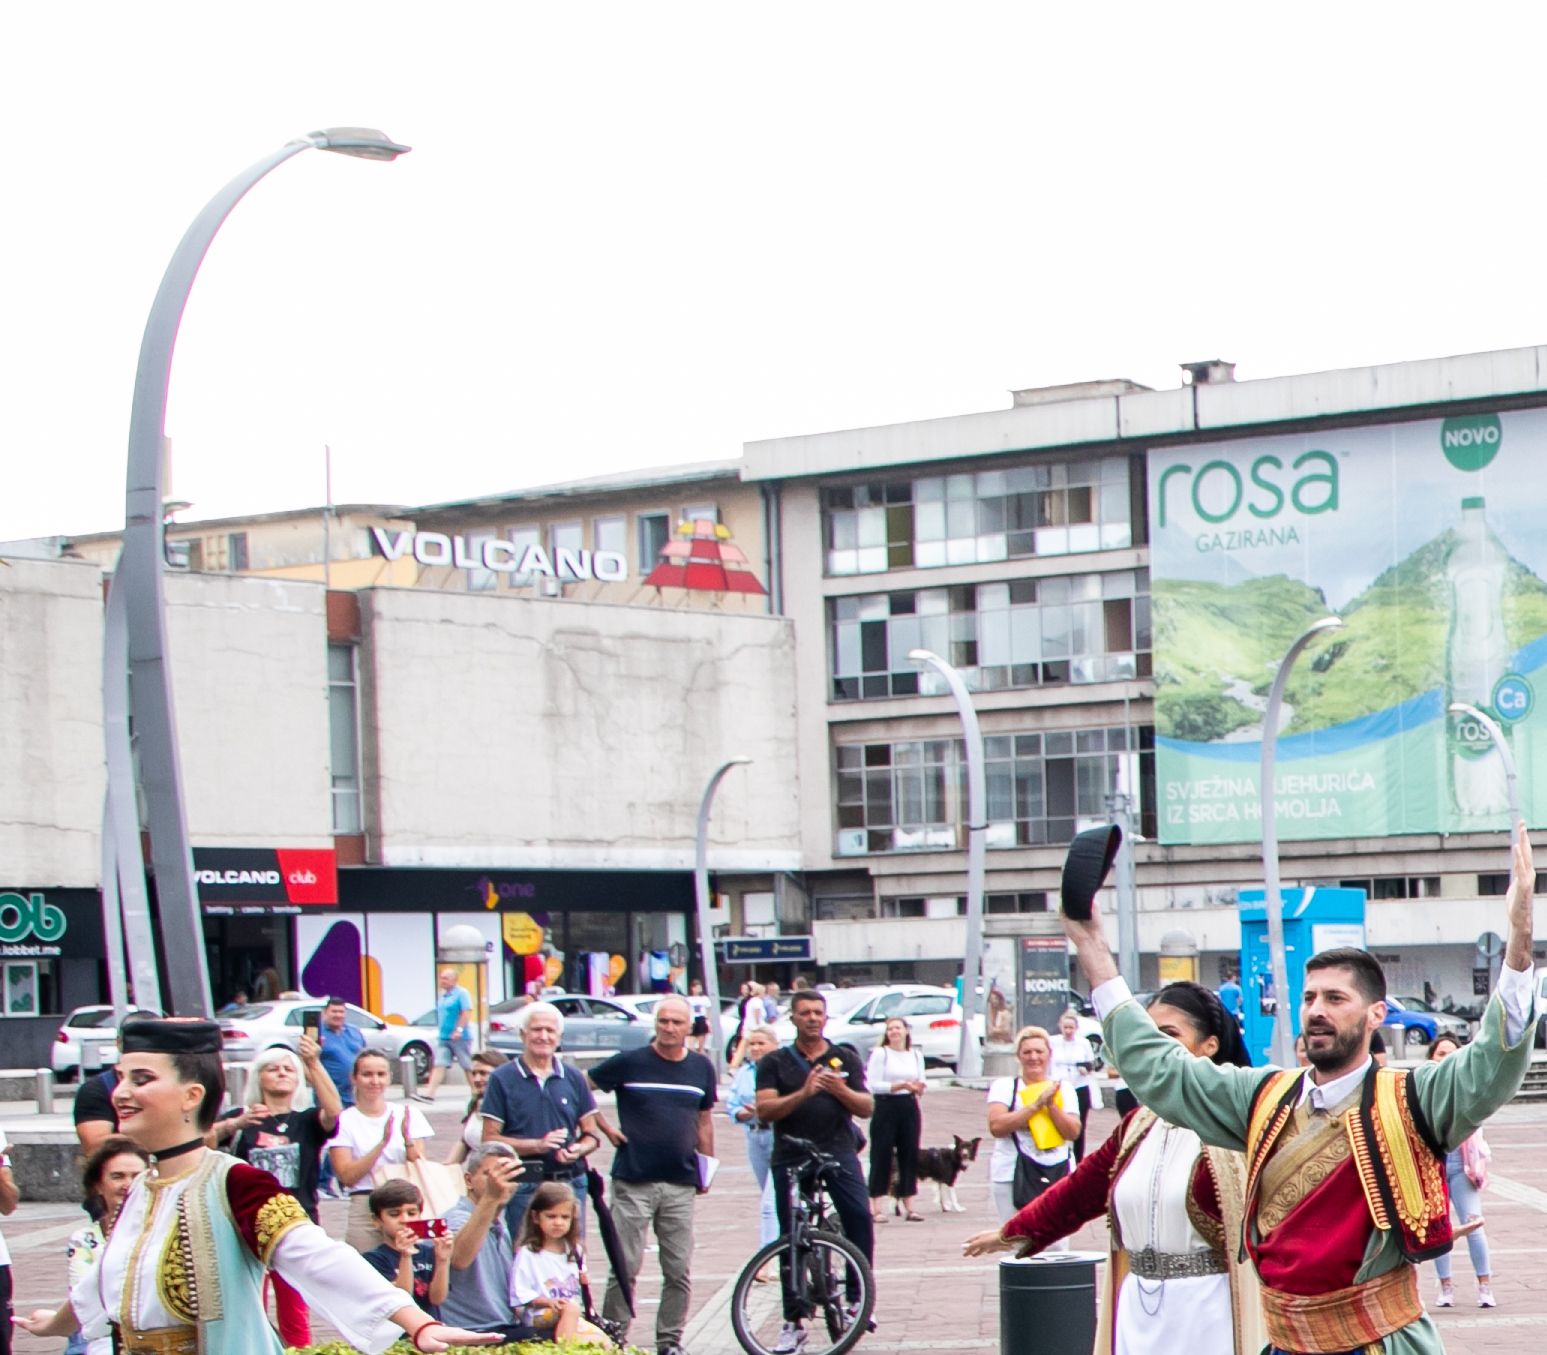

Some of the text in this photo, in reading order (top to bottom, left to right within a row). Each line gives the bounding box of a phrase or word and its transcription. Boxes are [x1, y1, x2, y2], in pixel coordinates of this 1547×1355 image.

[1445, 426, 1499, 448] NOVO
[1158, 450, 1339, 528] rosa
[1195, 525, 1301, 553] GAZIRANA
[371, 527, 628, 582] VOLCANO
[1497, 688, 1526, 710] Ca
[1456, 721, 1502, 741] ros
[1166, 768, 1376, 800] SVJEŽINA JEHURIĆA
[1166, 798, 1342, 824] IZ SRCA HMOLJA
[289, 868, 317, 885] club
[500, 881, 535, 899] one
